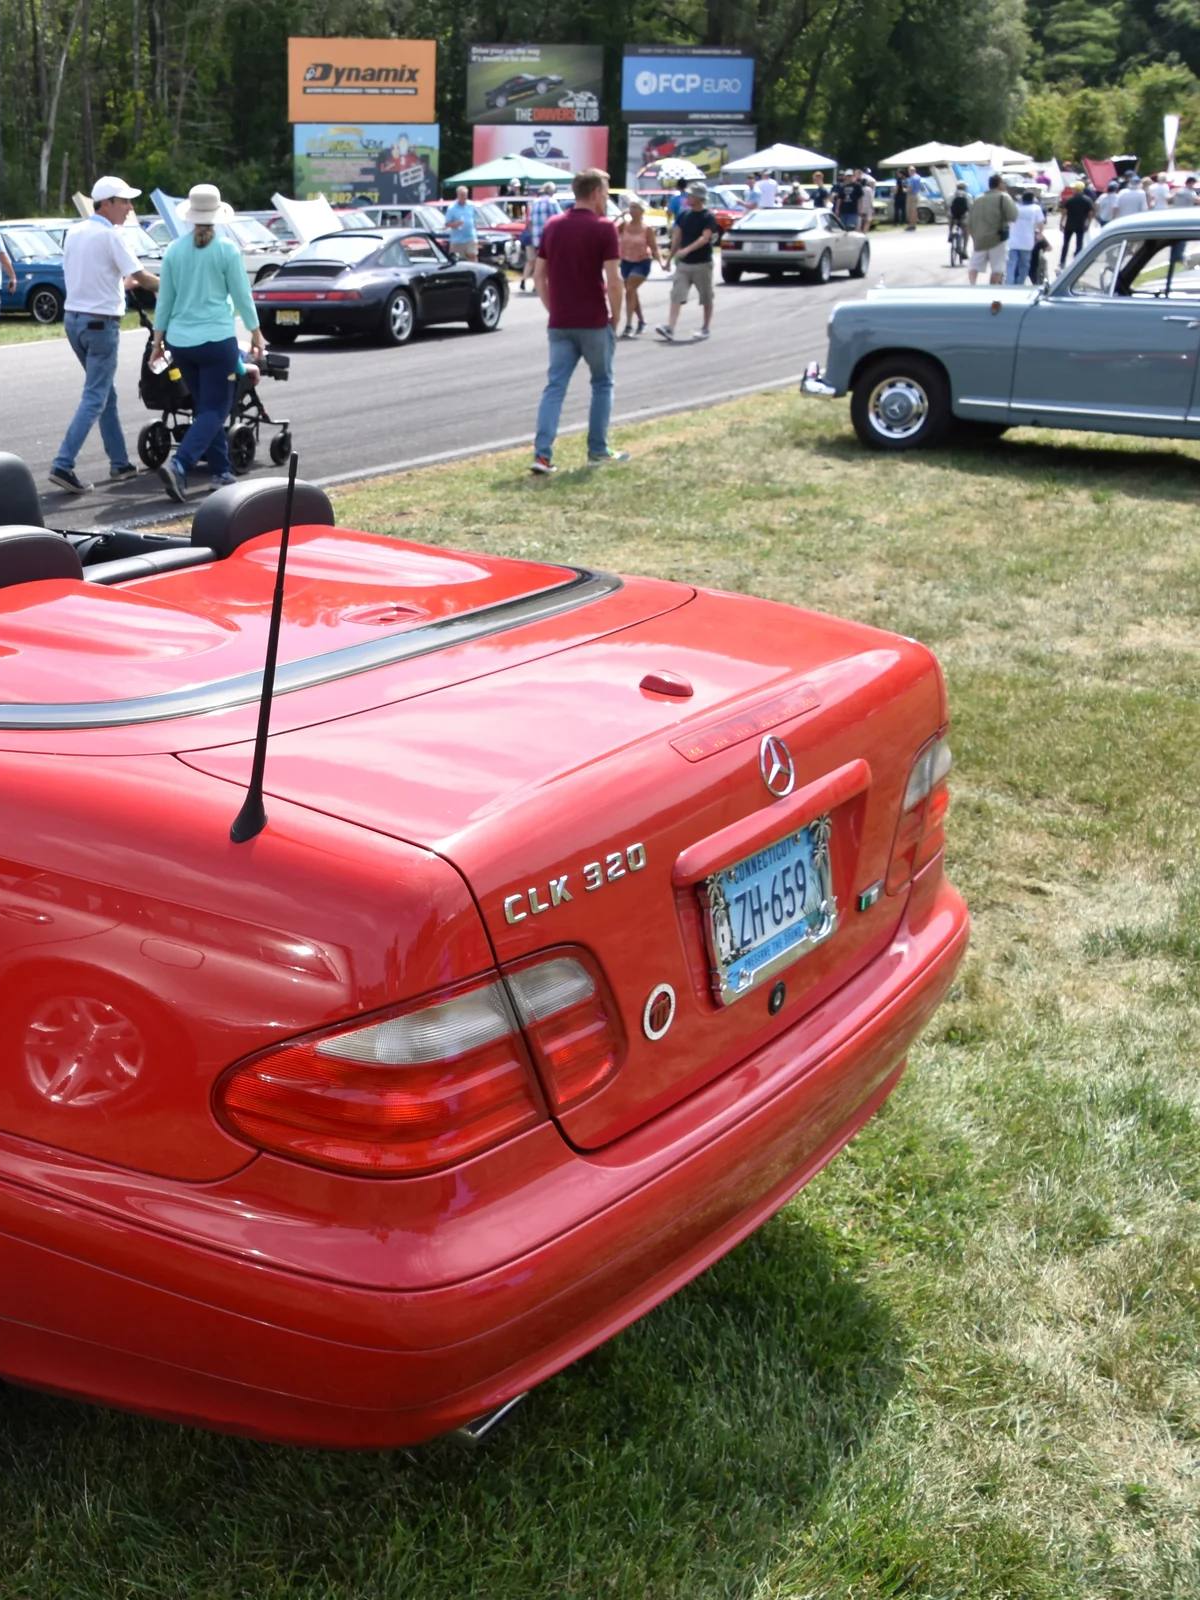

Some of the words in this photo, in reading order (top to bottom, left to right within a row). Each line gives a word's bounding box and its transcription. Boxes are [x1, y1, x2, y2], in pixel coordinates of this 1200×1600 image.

[303, 62, 420, 86] Dynamix
[659, 73, 701, 94] FCP
[703, 78, 742, 94] EURO
[733, 838, 794, 884] CONNECTICUT
[504, 874, 573, 924] CLK
[583, 842, 647, 891] 320
